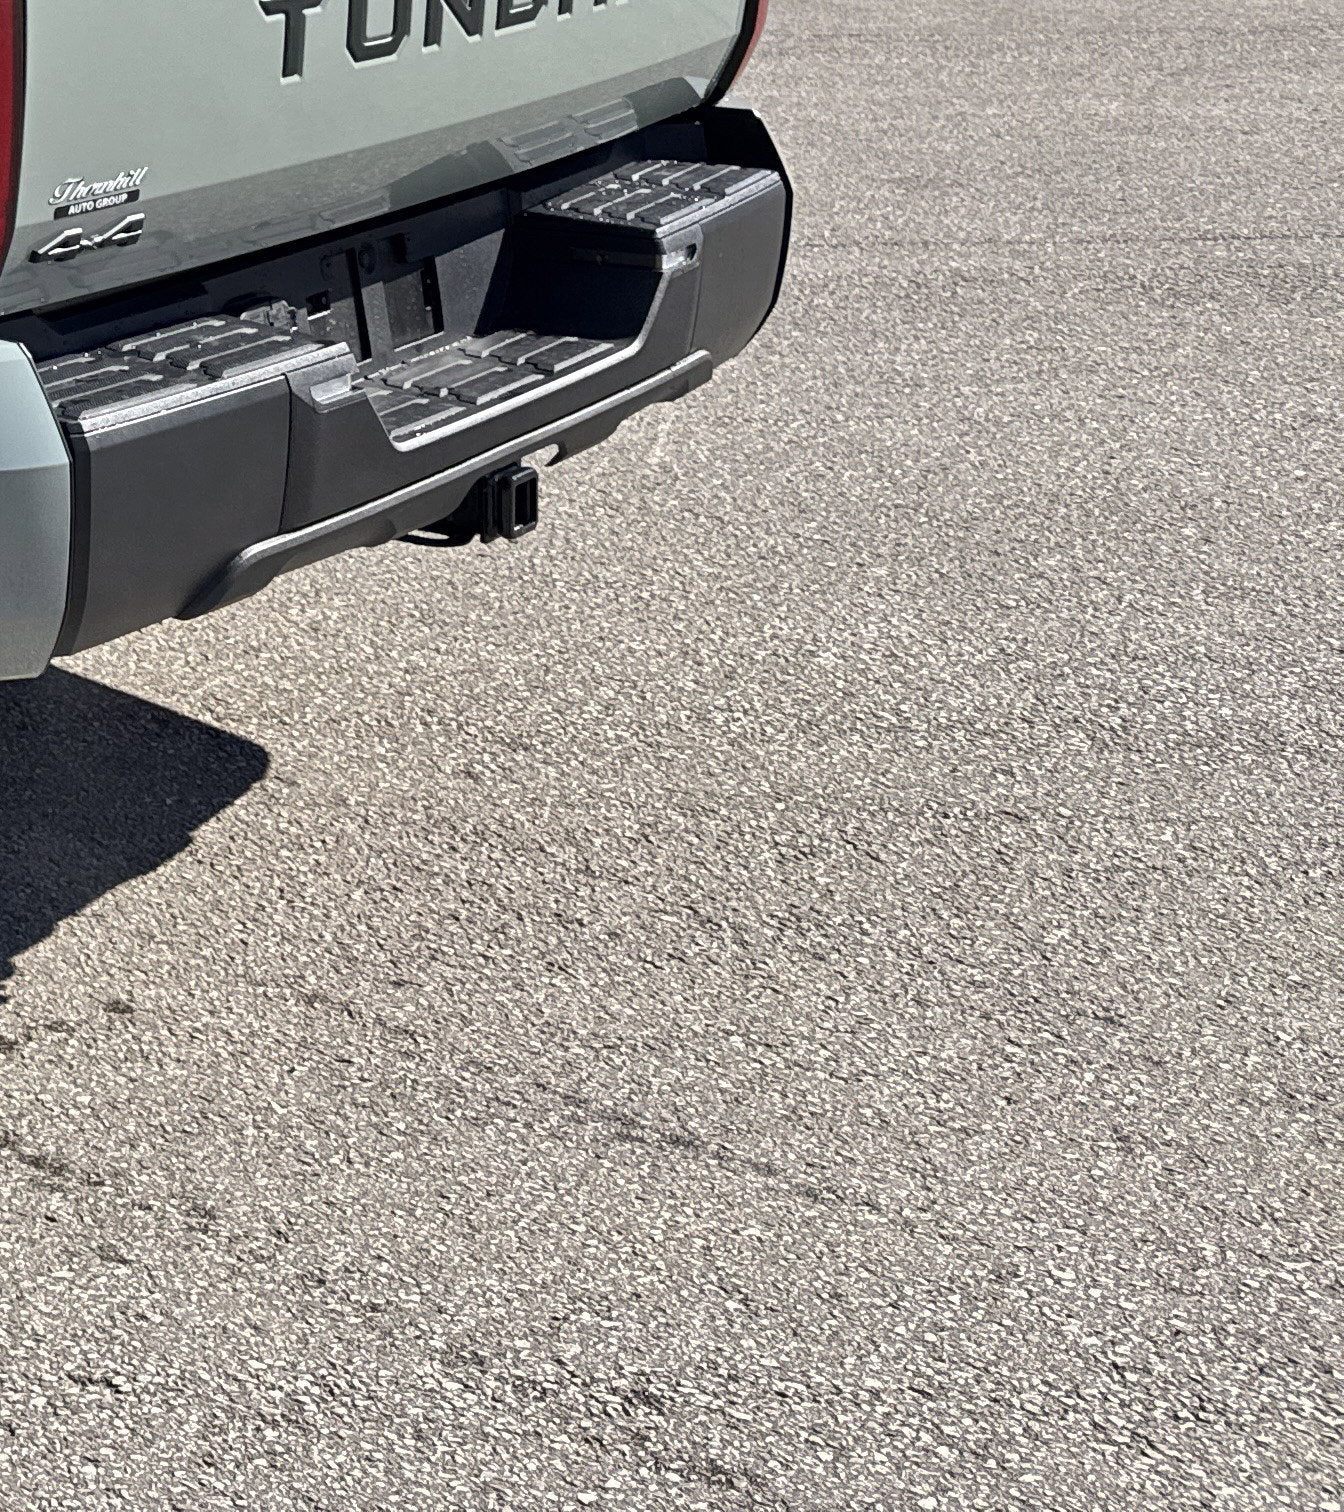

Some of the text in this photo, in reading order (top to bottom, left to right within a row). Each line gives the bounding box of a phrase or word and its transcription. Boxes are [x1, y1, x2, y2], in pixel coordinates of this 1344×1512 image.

[48, 166, 149, 205] Thornhill
[68, 192, 128, 215] AUTO GROUP
[28, 212, 146, 263] 4x4
